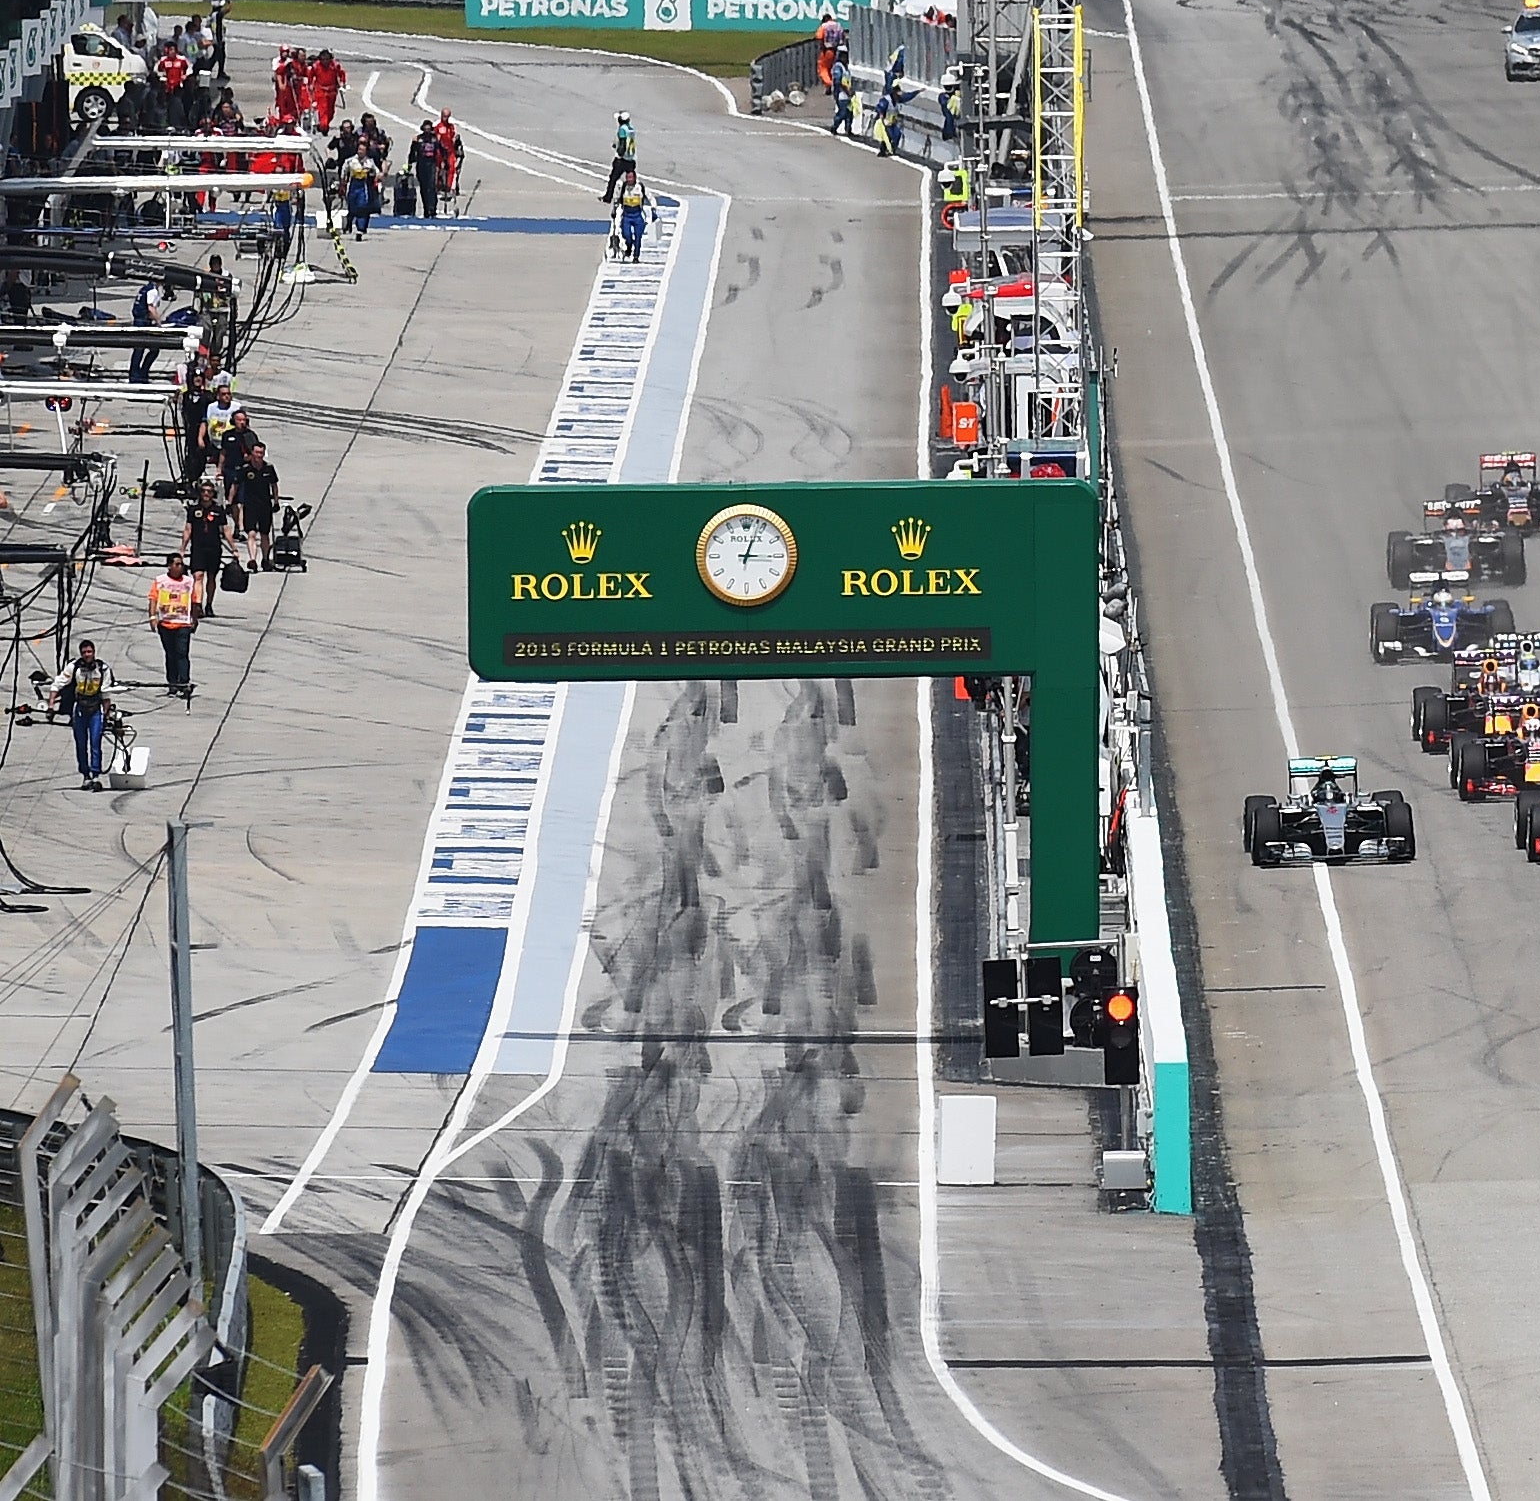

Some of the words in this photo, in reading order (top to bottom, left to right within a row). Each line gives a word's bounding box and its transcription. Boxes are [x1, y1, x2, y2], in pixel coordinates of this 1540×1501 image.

[510, 572, 654, 601] ROLEX
[840, 568, 982, 596] ROLEX
[514, 642, 562, 657] 2015
[567, 641, 653, 656] FORMULA
[660, 641, 668, 656] 1
[675, 640, 770, 656] PETRONAS
[776, 638, 868, 654] MALAYSIA
[872, 637, 935, 653] GRAND
[940, 636, 982, 652] PRIX
